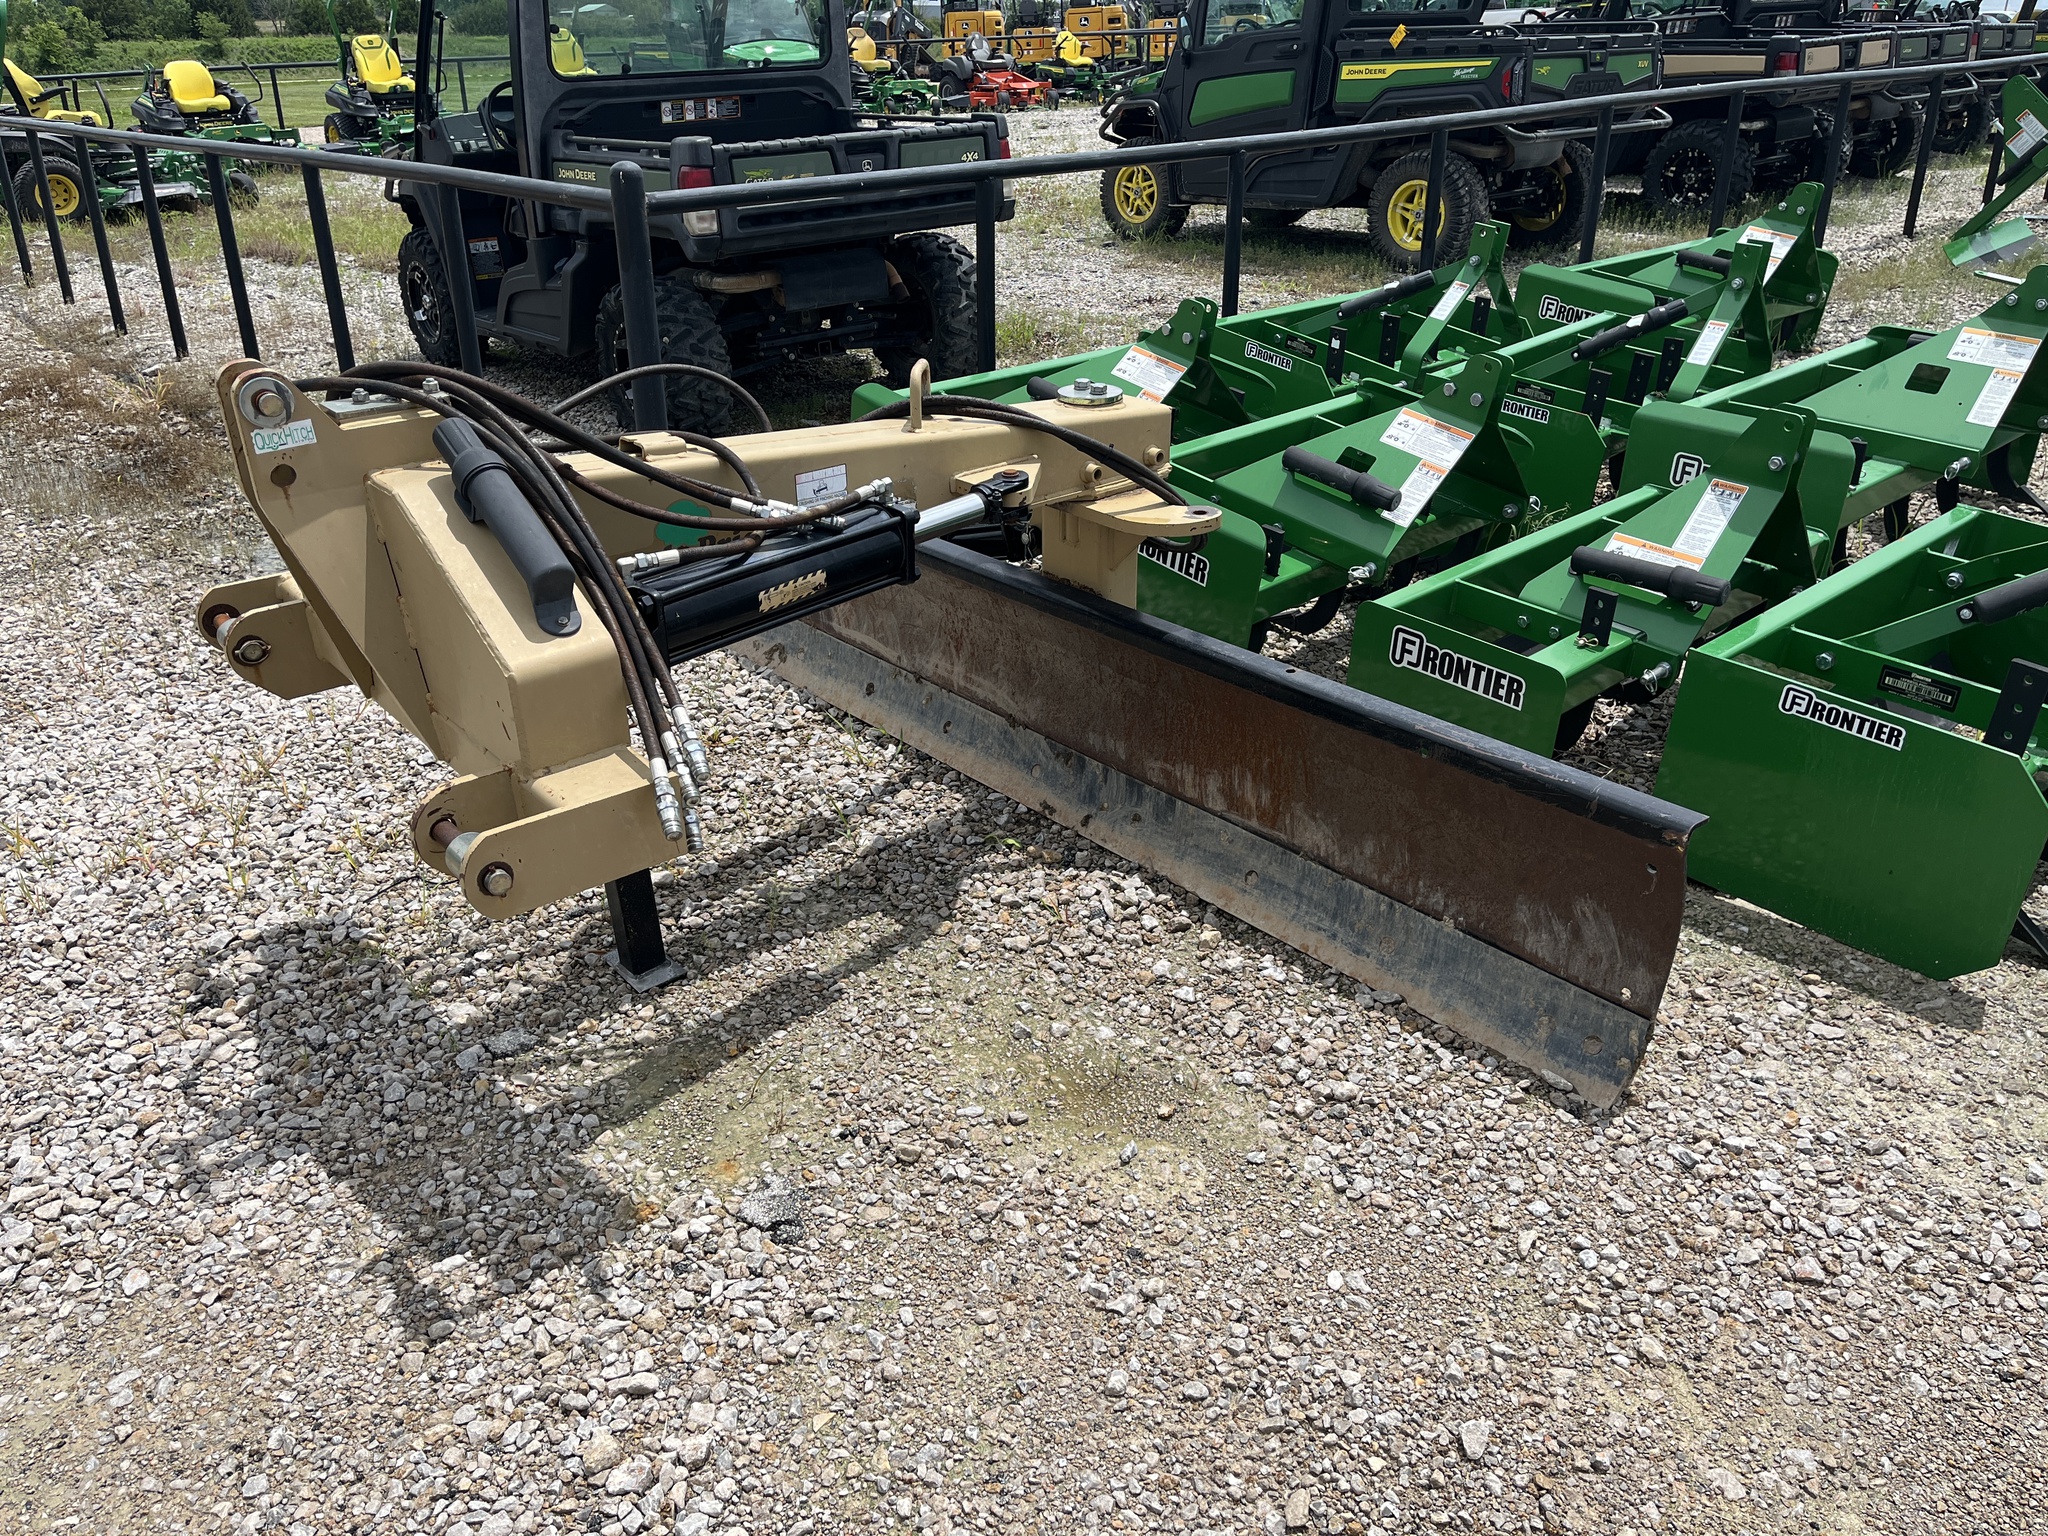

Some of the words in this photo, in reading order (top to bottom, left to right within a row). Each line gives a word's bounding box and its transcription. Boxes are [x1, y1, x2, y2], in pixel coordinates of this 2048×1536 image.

[1346, 68, 1364, 76] JOHN
[961, 151, 979, 163] 4X4
[558, 168, 575, 179] JOHN
[575, 168, 597, 181] DEERE
[1540, 295, 1597, 324] FRONT
[1246, 341, 1292, 370] FRONTIER
[1502, 399, 1549, 422] RONTIER
[1719, 484, 1746, 493] WARNING
[1649, 545, 1675, 557] WARNING
[1138, 543, 1208, 585] ONTIER
[1391, 627, 1524, 708] FRONTIER
[1780, 686, 1903, 748] FRONTIER
